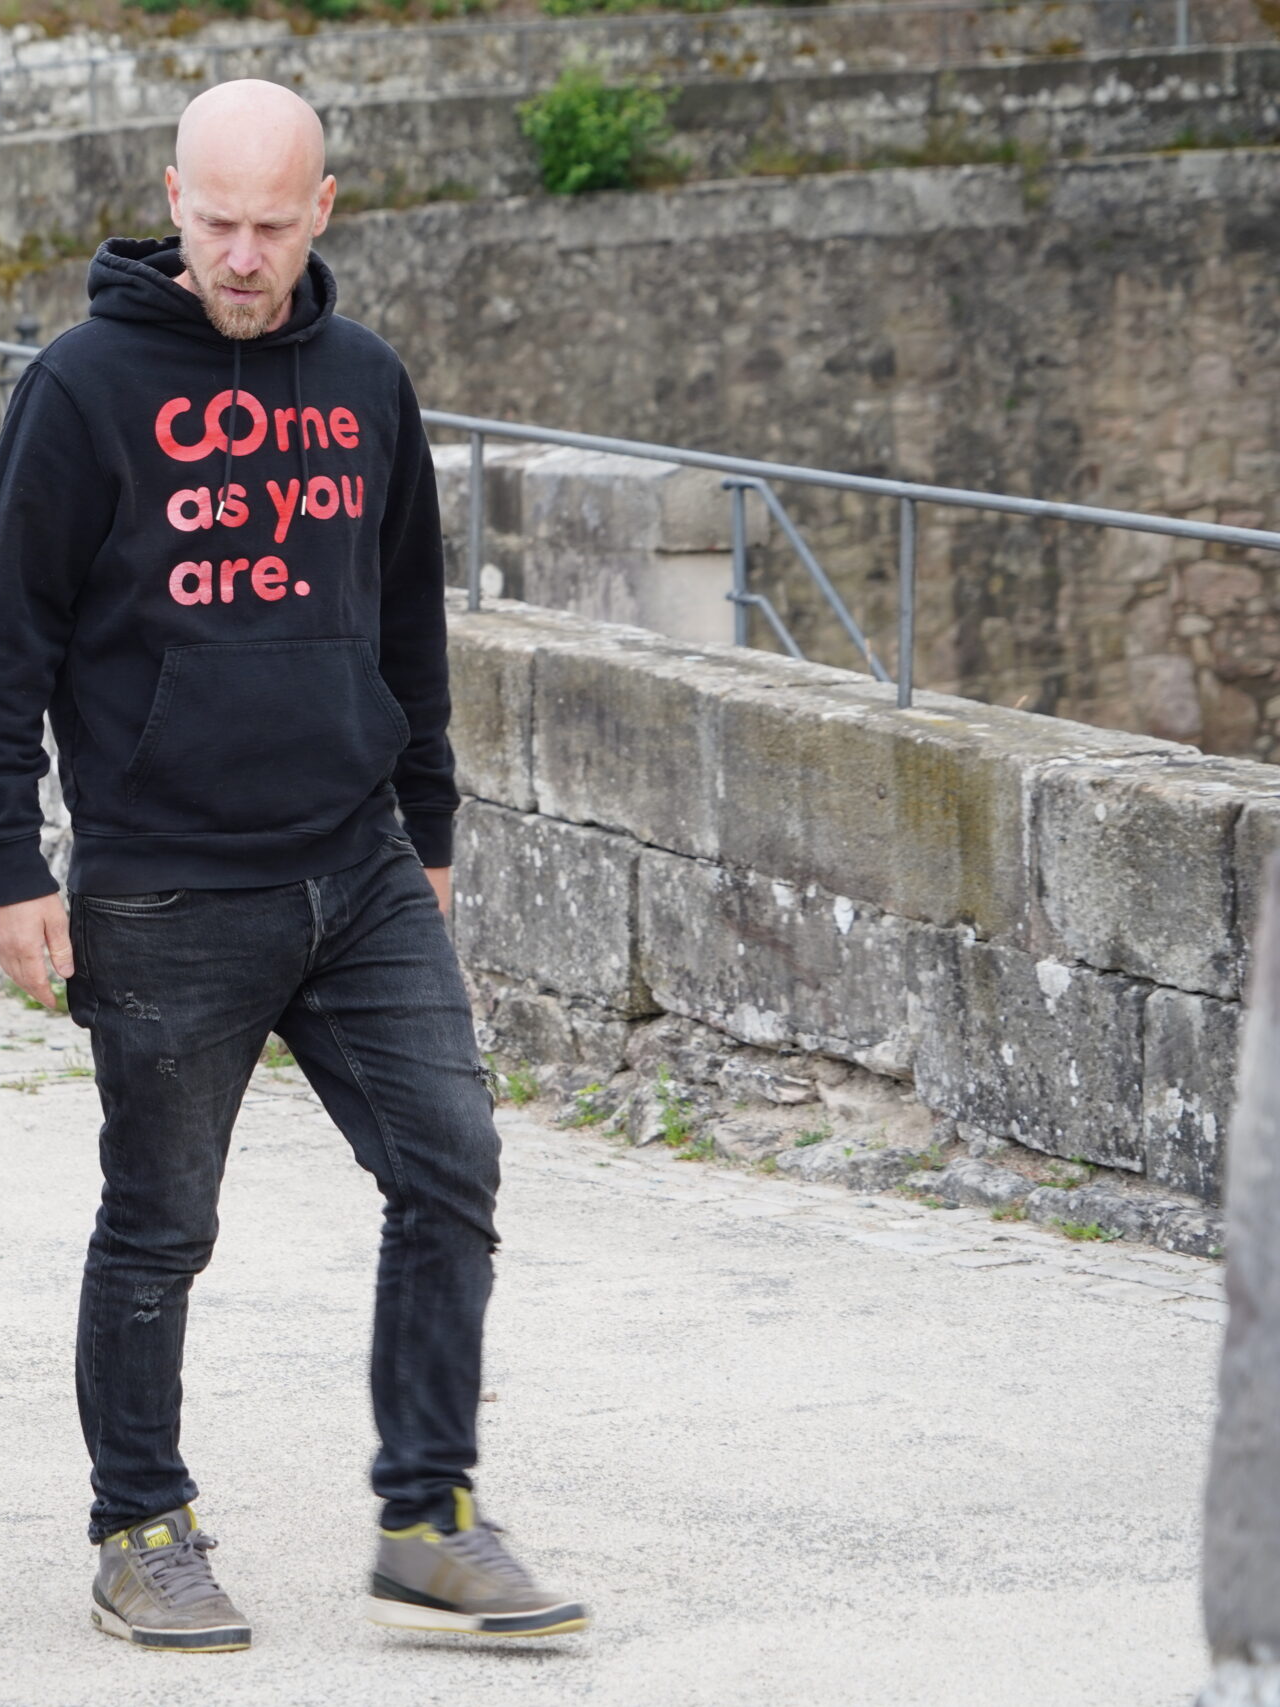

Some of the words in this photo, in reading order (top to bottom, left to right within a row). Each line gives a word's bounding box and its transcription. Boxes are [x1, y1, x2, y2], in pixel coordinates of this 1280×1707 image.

[167, 483, 250, 532] as
[266, 475, 364, 544] you
[169, 555, 311, 606] are.
